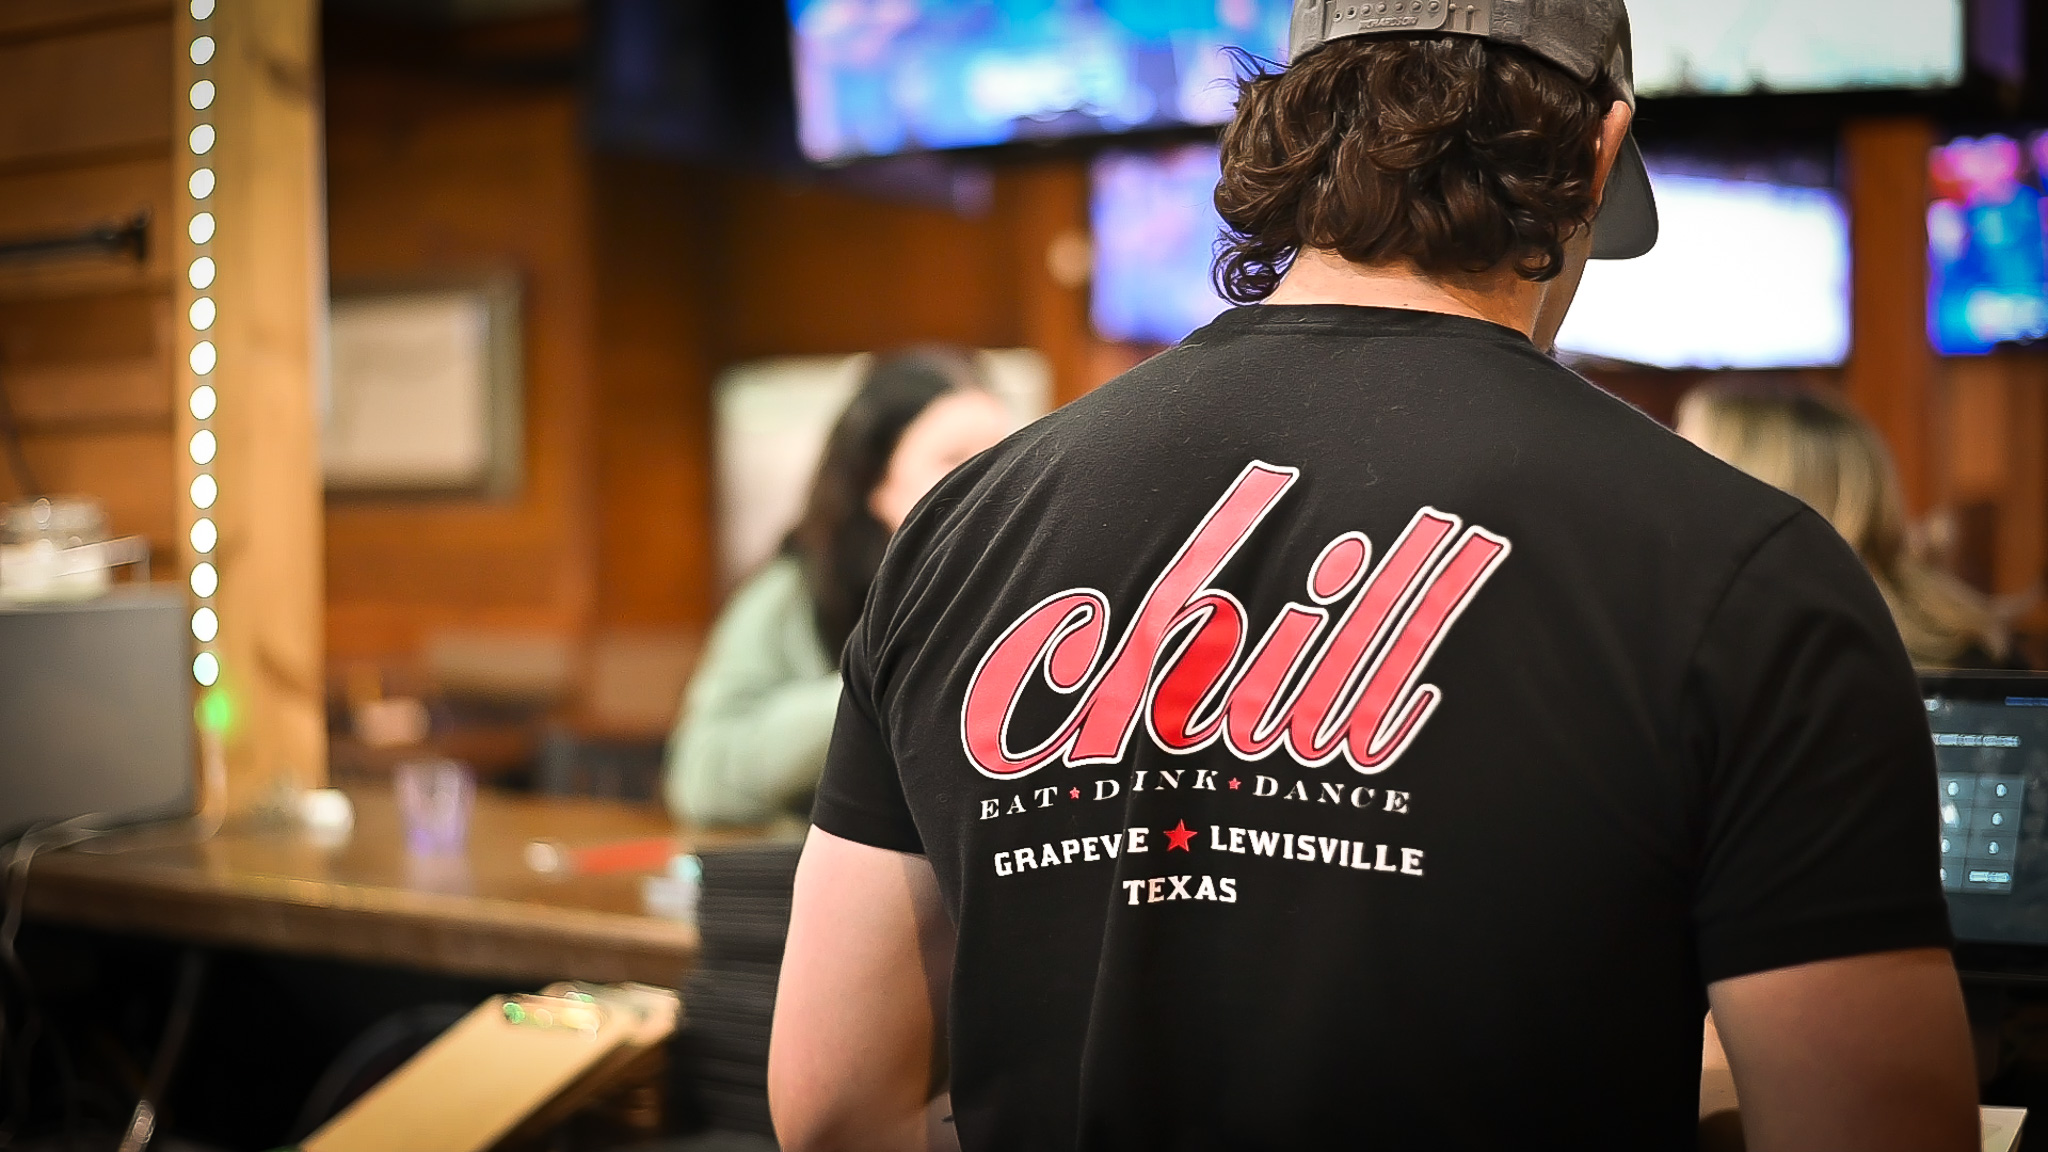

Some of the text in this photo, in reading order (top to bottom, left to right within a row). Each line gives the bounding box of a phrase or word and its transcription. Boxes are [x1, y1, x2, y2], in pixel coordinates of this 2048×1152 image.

[961, 460, 1511, 779] chill
[979, 769, 1412, 821] EAT DINK DANCE
[1210, 825, 1425, 876] LEWISVILLE
[1123, 876, 1238, 905] TEXAS
